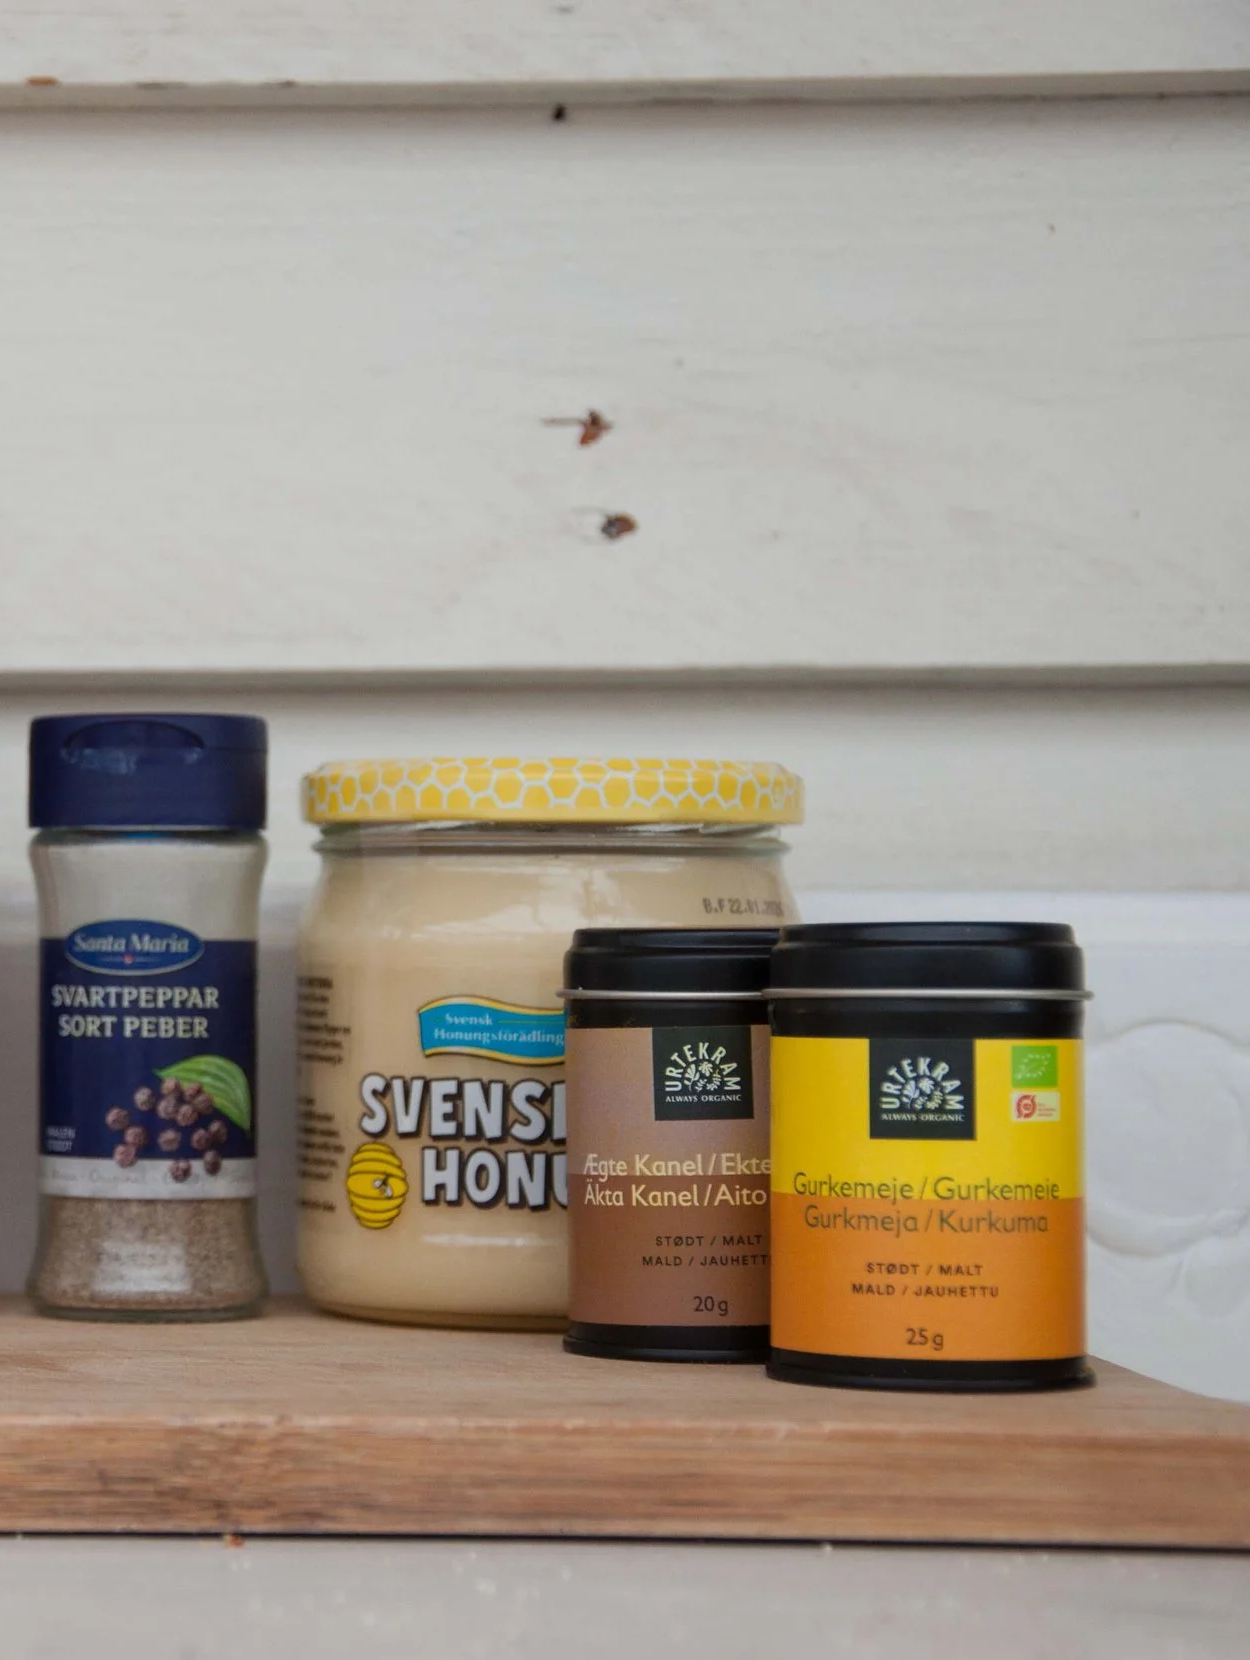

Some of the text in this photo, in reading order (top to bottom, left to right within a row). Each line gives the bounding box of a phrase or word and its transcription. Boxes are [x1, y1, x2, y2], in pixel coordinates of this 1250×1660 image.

[74, 932, 191, 954] Santa Maria
[51, 984, 220, 1009] SVARTPEPPAR
[58, 1015, 209, 1039] SORT PEBER
[445, 1013, 493, 1025] Svensk
[664, 1042, 741, 1091] URTEKRAM
[879, 1056, 964, 1110] URTEKRAM
[665, 1094, 742, 1103] ALWAYS ORGANIC
[881, 1113, 965, 1121] ALWAYS ORGANIC
[584, 1154, 628, 1182] Ægte
[635, 1154, 704, 1176] Kanel
[721, 1153, 771, 1176] Ekte
[584, 1179, 624, 1206] Äkta
[631, 1184, 699, 1206] Kanel
[714, 1183, 767, 1206] Aito
[794, 1172, 914, 1204] Gurkemeje
[934, 1176, 1060, 1200] Gurkemeie
[804, 1205, 919, 1237] Gurkmeja
[939, 1210, 1048, 1232] Kurkuma
[655, 1236, 704, 1246] STØDT
[722, 1235, 762, 1245] MALT
[642, 1256, 682, 1266] MALD
[700, 1255, 771, 1266] JAUHETT
[866, 1263, 920, 1275] STØDT
[939, 1264, 982, 1276] MALT
[852, 1283, 895, 1295] MALD
[915, 1285, 999, 1297] JAUHETTU
